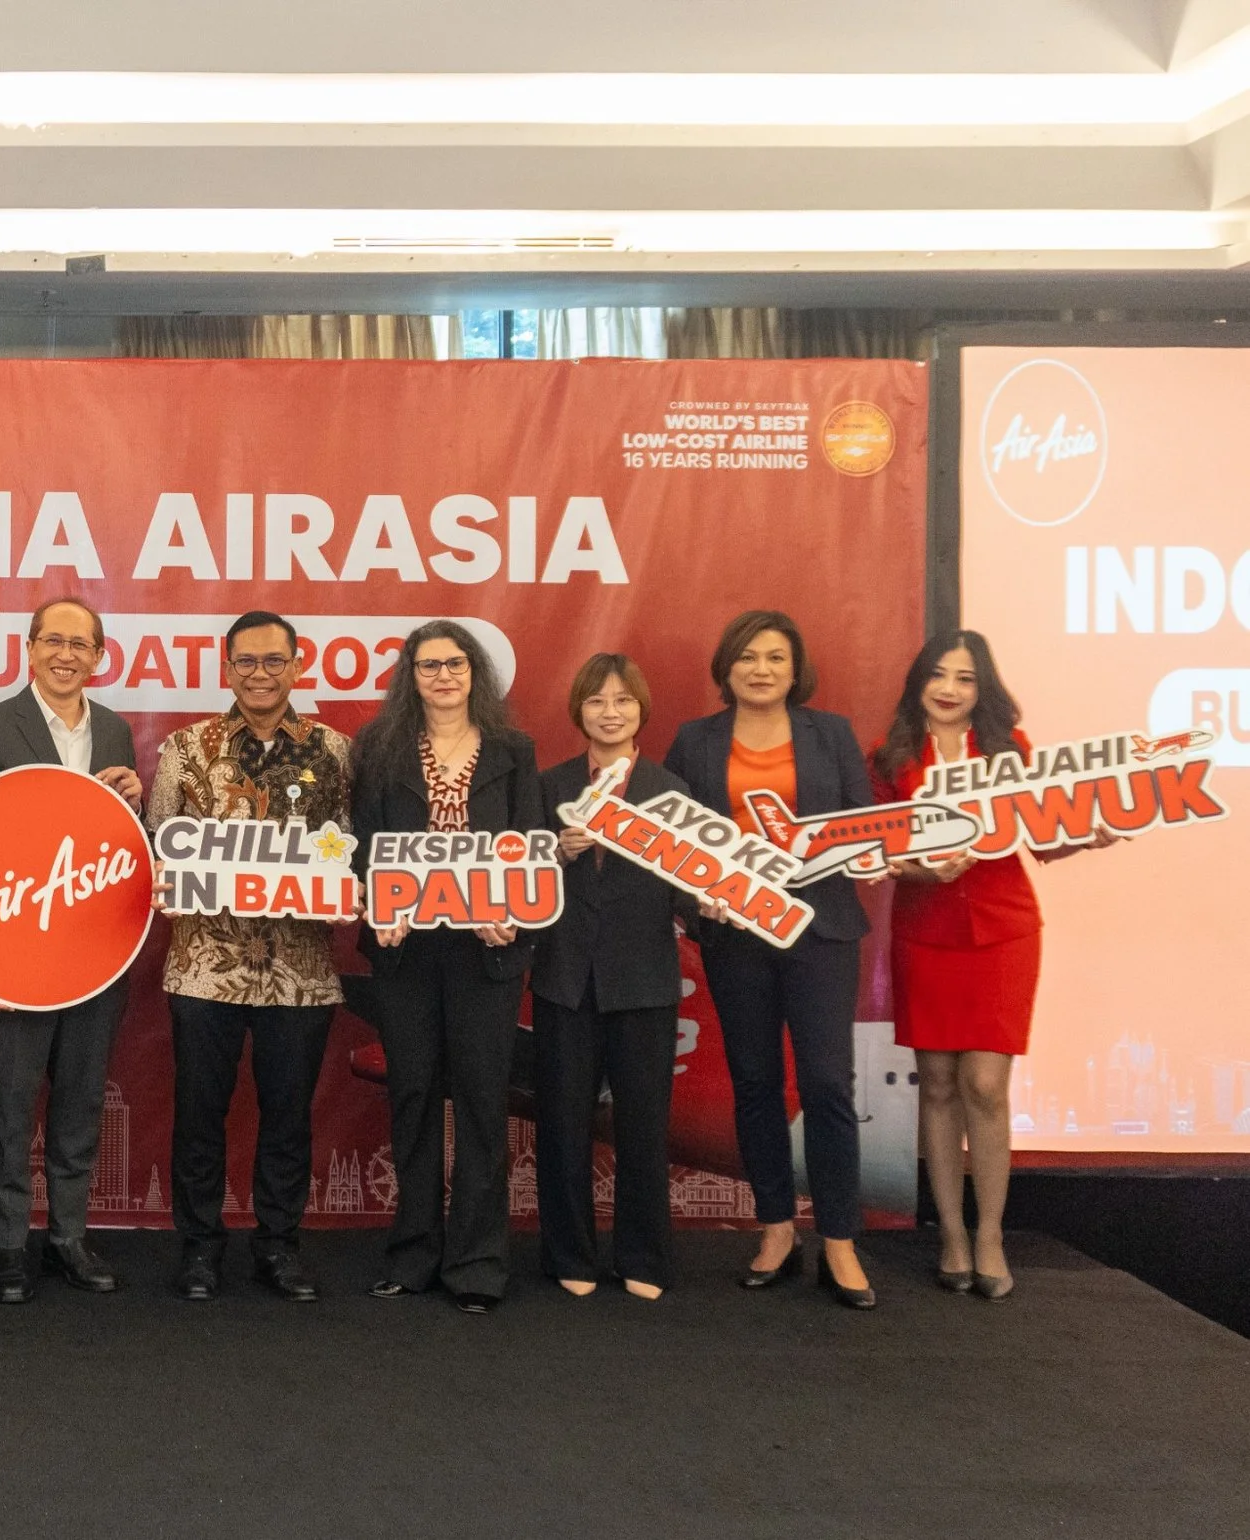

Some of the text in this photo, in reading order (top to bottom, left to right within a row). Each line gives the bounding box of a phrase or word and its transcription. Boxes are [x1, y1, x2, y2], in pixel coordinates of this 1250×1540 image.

[664, 414, 809, 431] WORLD'S BEST
[670, 401, 809, 411] CROWNED BY SKYTRAX
[623, 433, 728, 449] LOW-COST
[732, 434, 808, 450] AIRLINE
[623, 452, 808, 469] 16 YEARS RUNNING
[131, 492, 630, 584] AIRASIA
[920, 735, 1127, 799] JELAJAHI
[928, 758, 1226, 862] UWUK
[160, 821, 311, 864] CHILL
[645, 796, 798, 884] AYO KE
[164, 870, 353, 916] IN BALI
[372, 867, 558, 925] PALU
[586, 799, 807, 941] KENDARI
